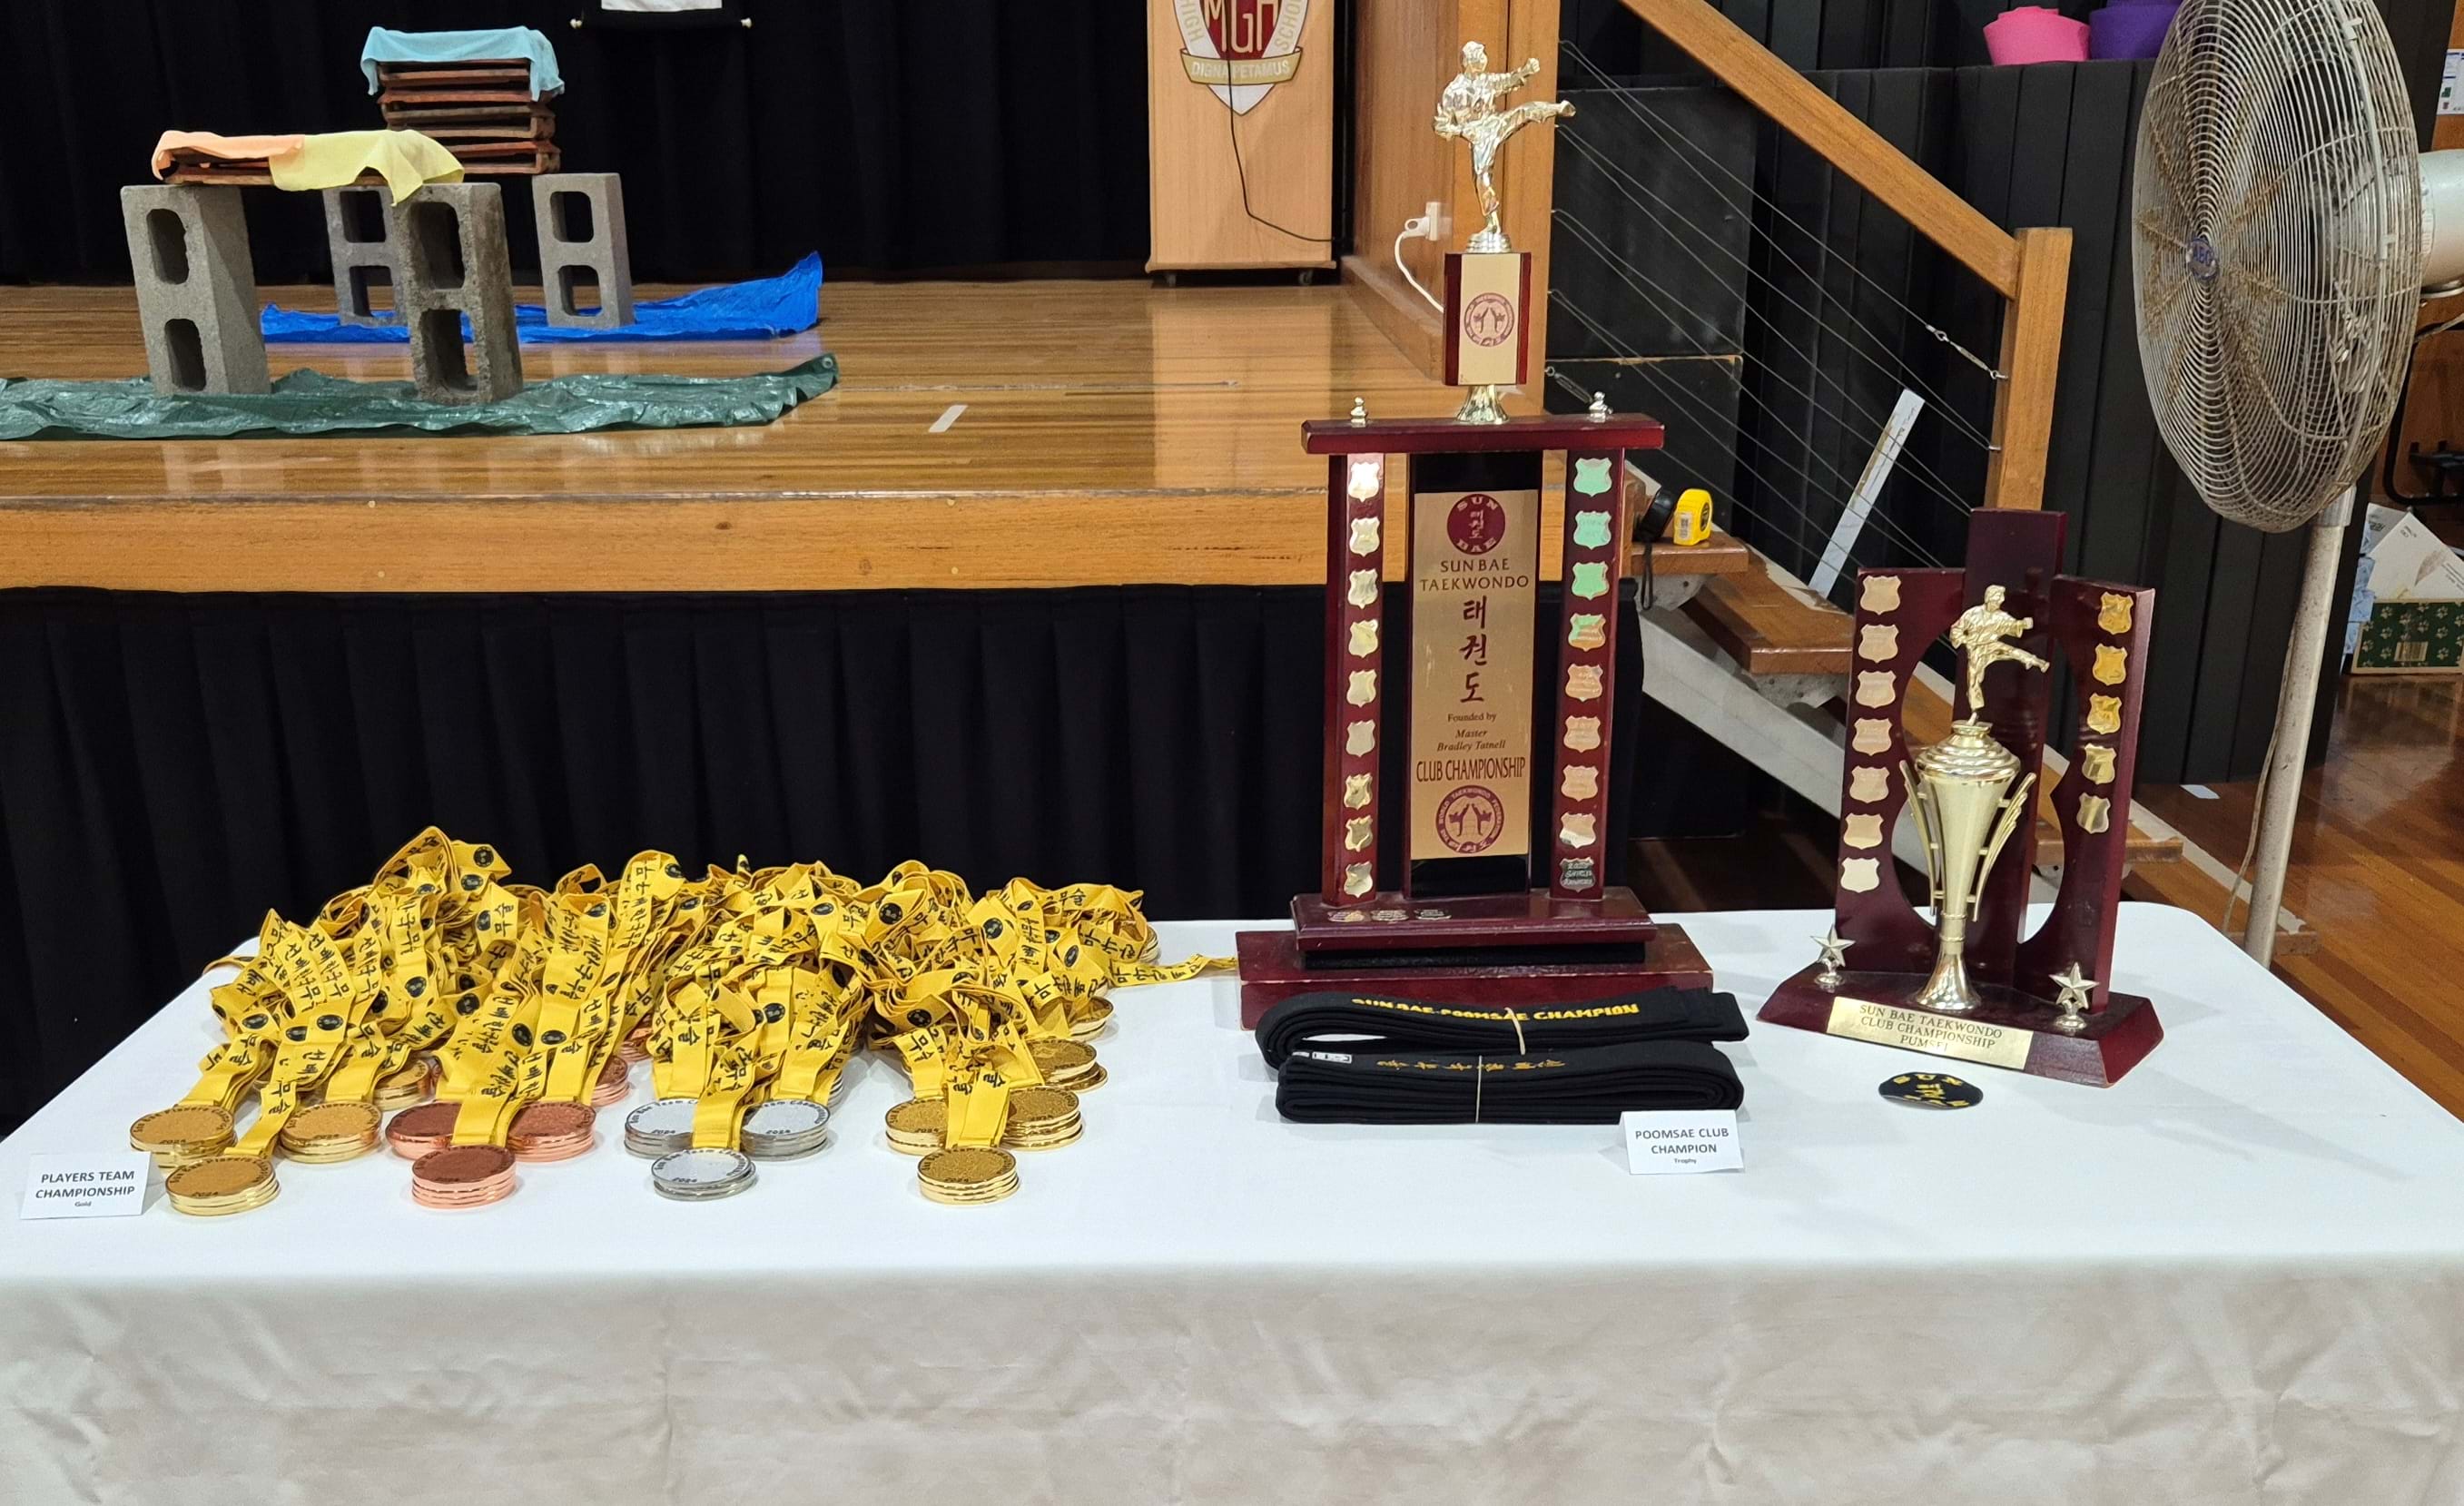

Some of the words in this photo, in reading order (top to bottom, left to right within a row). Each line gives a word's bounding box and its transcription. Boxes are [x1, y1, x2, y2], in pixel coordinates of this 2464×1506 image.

[1274, 0, 1302, 51] SCHO
[1440, 559, 1474, 573] SUN
[1478, 558, 1510, 572] BAE
[1420, 575, 1529, 592] TAEKWONDO
[1447, 713, 1484, 723] Founded
[1486, 713, 1496, 723] by
[1455, 729, 1488, 739] Master
[1436, 742, 1473, 752] Bradley
[1474, 740, 1506, 751] Tatnell
[1416, 760, 1444, 783] CLUB
[1445, 756, 1526, 781] CHAMPIONSHIP
[1533, 1003, 1641, 1020] CHAMPION
[1859, 1004, 1886, 1018] SUN
[1889, 1008, 1916, 1022] BAE
[1920, 1015, 2003, 1039] TAEKWONDO
[1860, 1016, 1894, 1030] CLUB
[1897, 1022, 1996, 1049] CHAMPIONSHIP
[1635, 1128, 1695, 1139] POOMSAE
[1699, 1127, 1730, 1137] CLUB
[1651, 1144, 1717, 1154] CHAMPION
[41, 1172, 94, 1184] PLAYERS
[98, 1170, 134, 1181] TEAM
[35, 1186, 135, 1198] CHAMPIONSHIP
